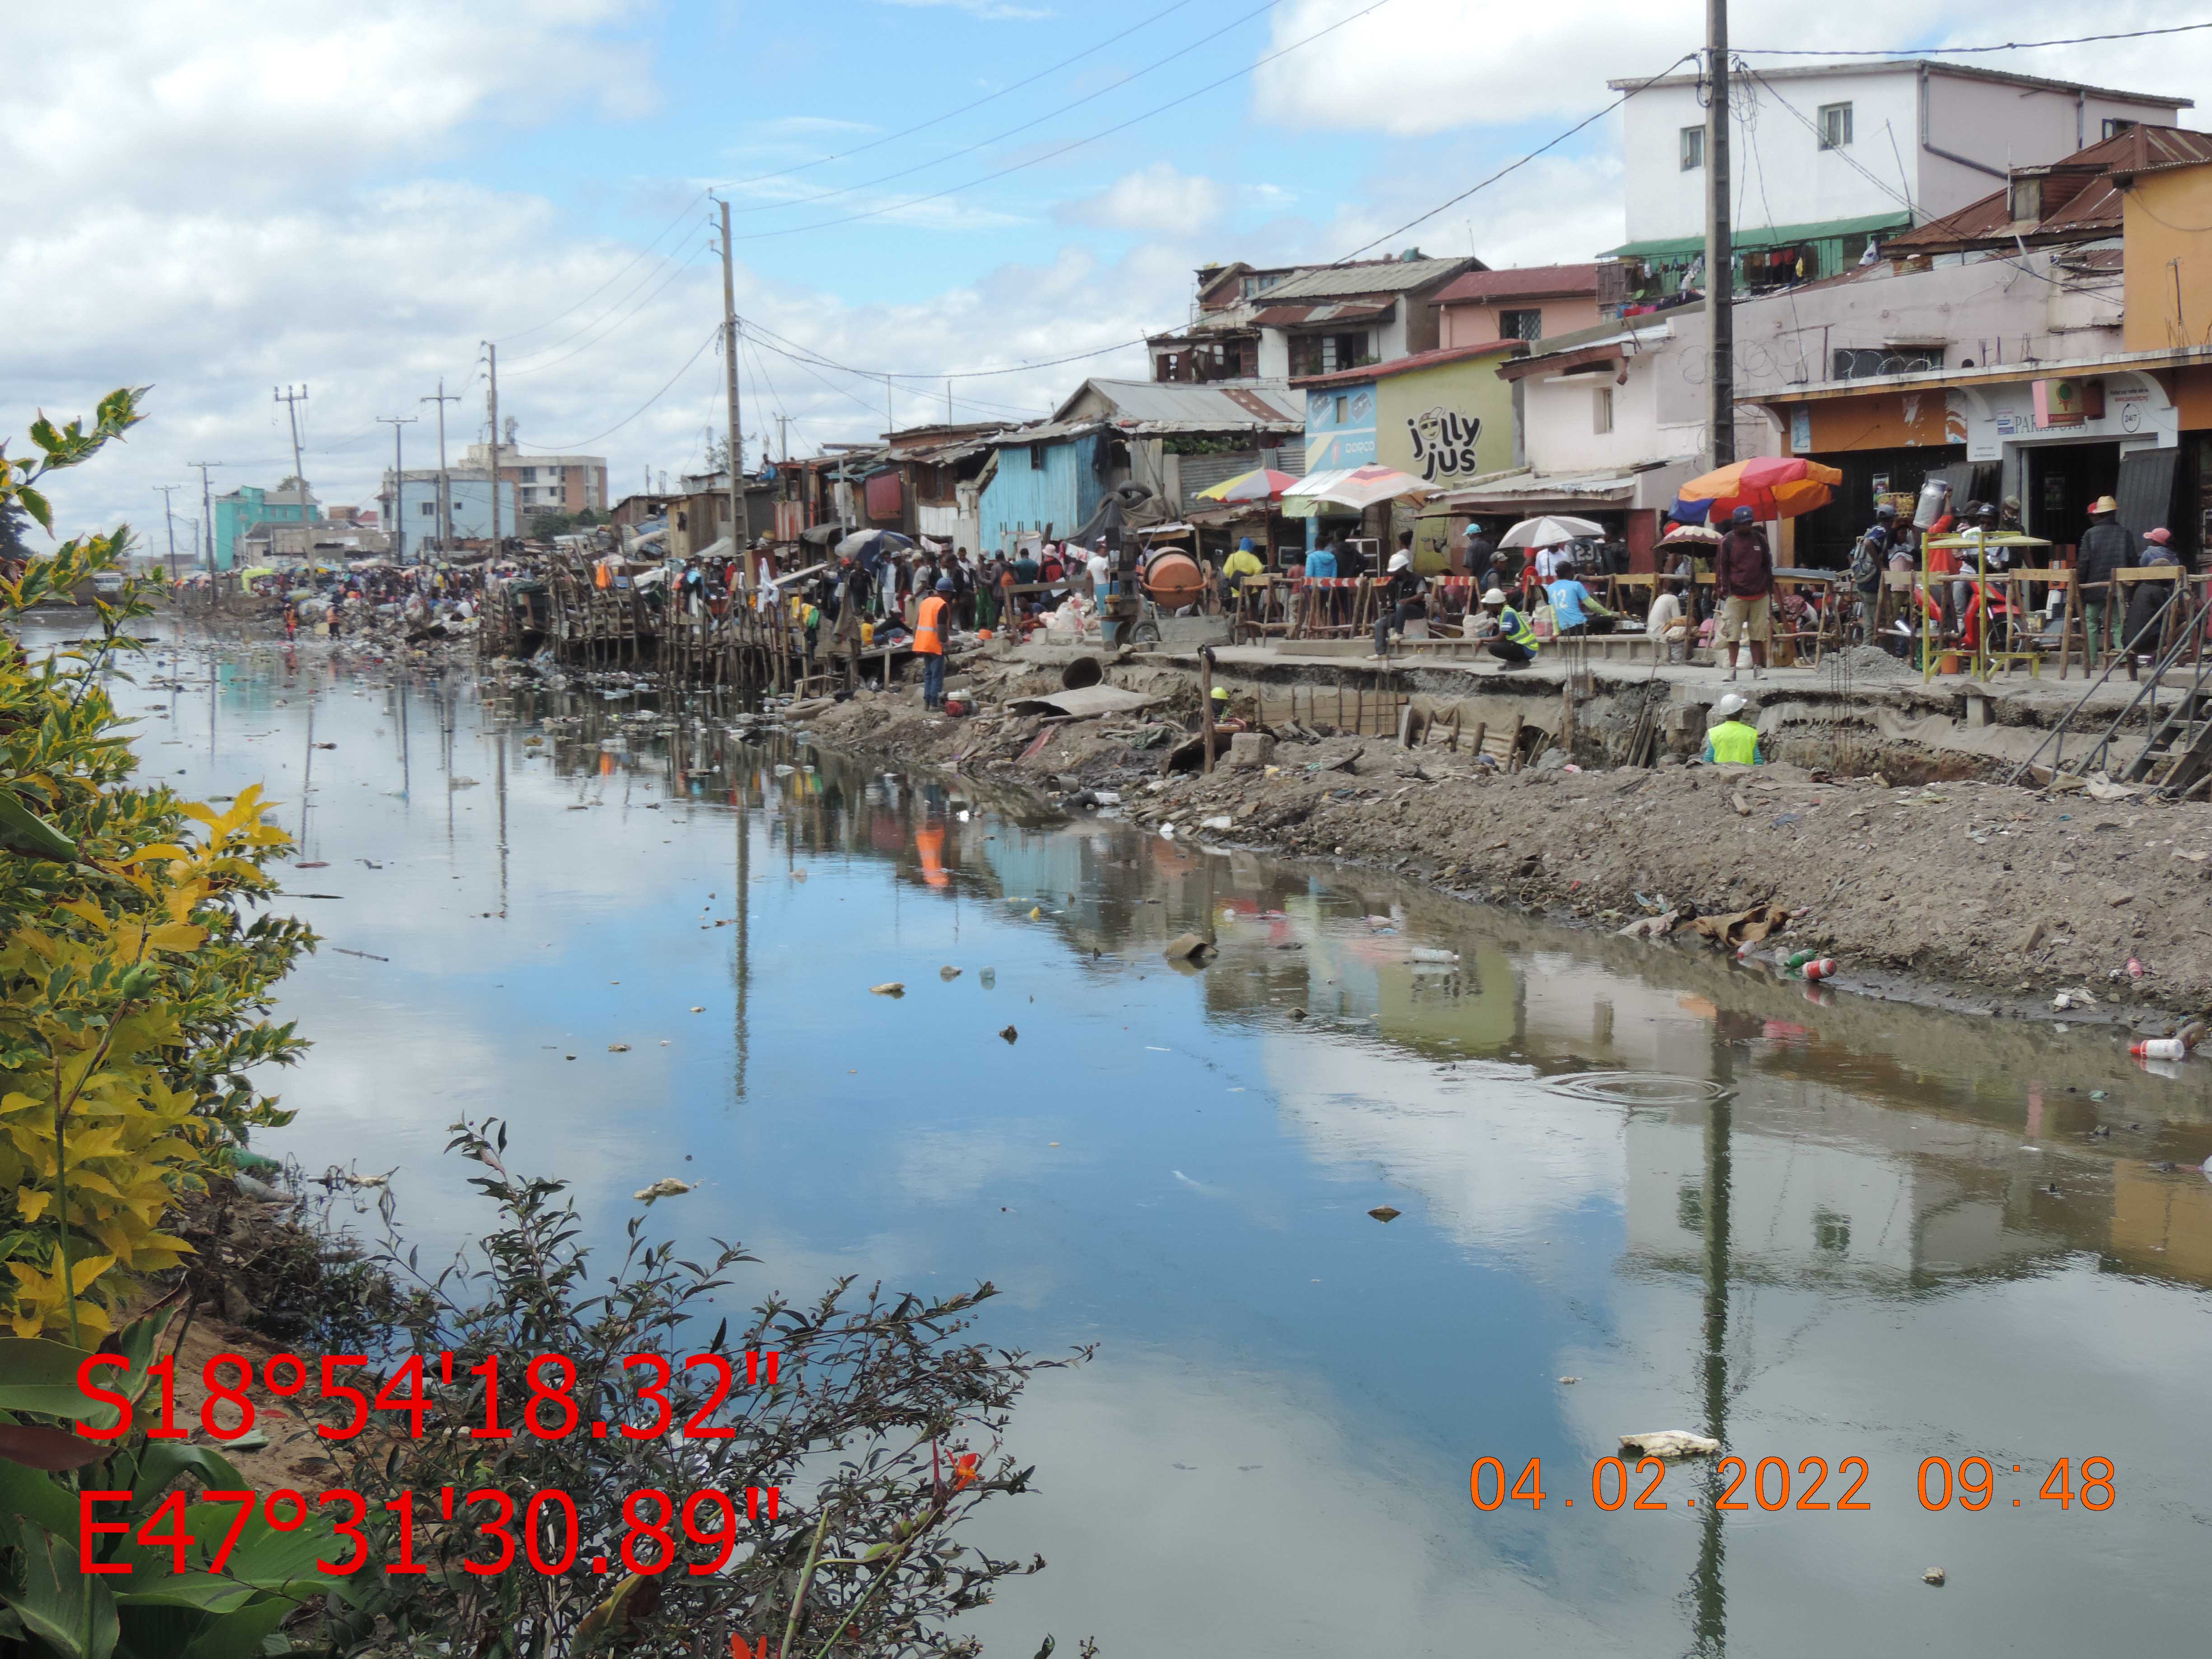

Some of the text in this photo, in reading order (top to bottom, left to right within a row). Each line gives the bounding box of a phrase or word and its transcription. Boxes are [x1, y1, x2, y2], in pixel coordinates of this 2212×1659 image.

[1345, 441, 1375, 454] DORCO
[1422, 442, 1475, 480] jus
[1552, 589, 1569, 609] 12
